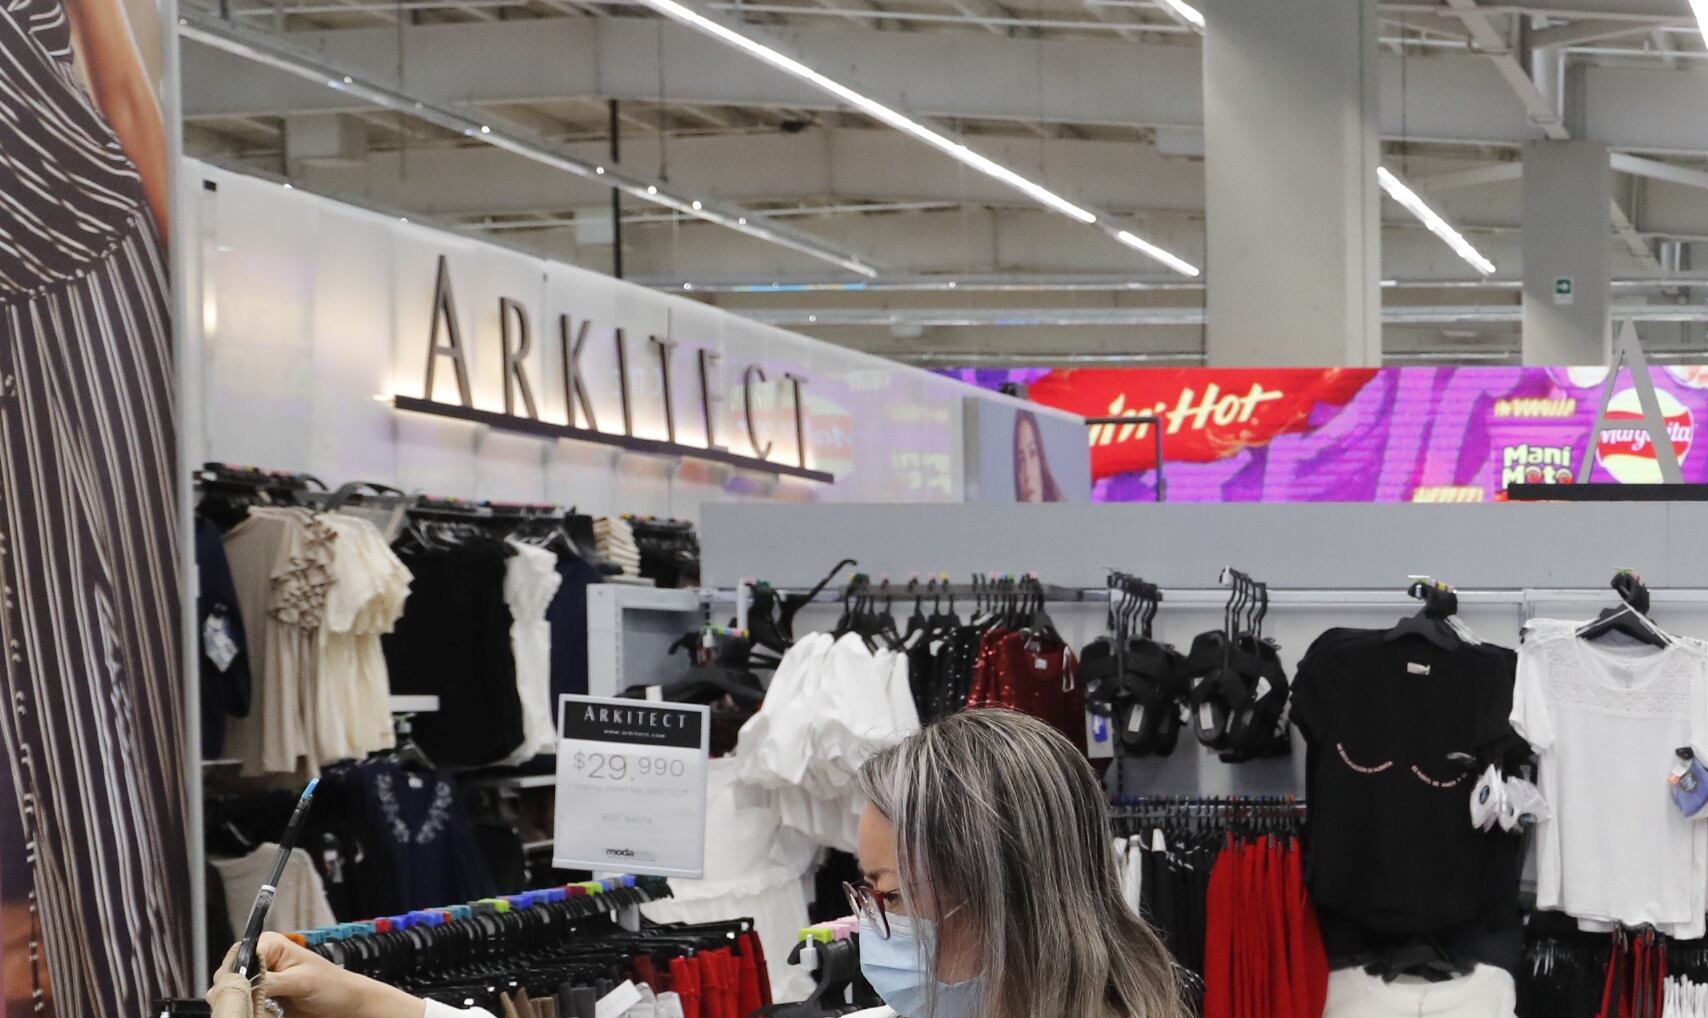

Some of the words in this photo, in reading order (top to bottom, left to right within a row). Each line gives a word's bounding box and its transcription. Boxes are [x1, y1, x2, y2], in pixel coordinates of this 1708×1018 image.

[424, 255, 808, 469] ARKITECT
[1166, 383, 1284, 434] Hot
[1600, 421, 1691, 452] Margita
[584, 705, 686, 729] ARKITECT
[573, 751, 685, 781] $29.990
